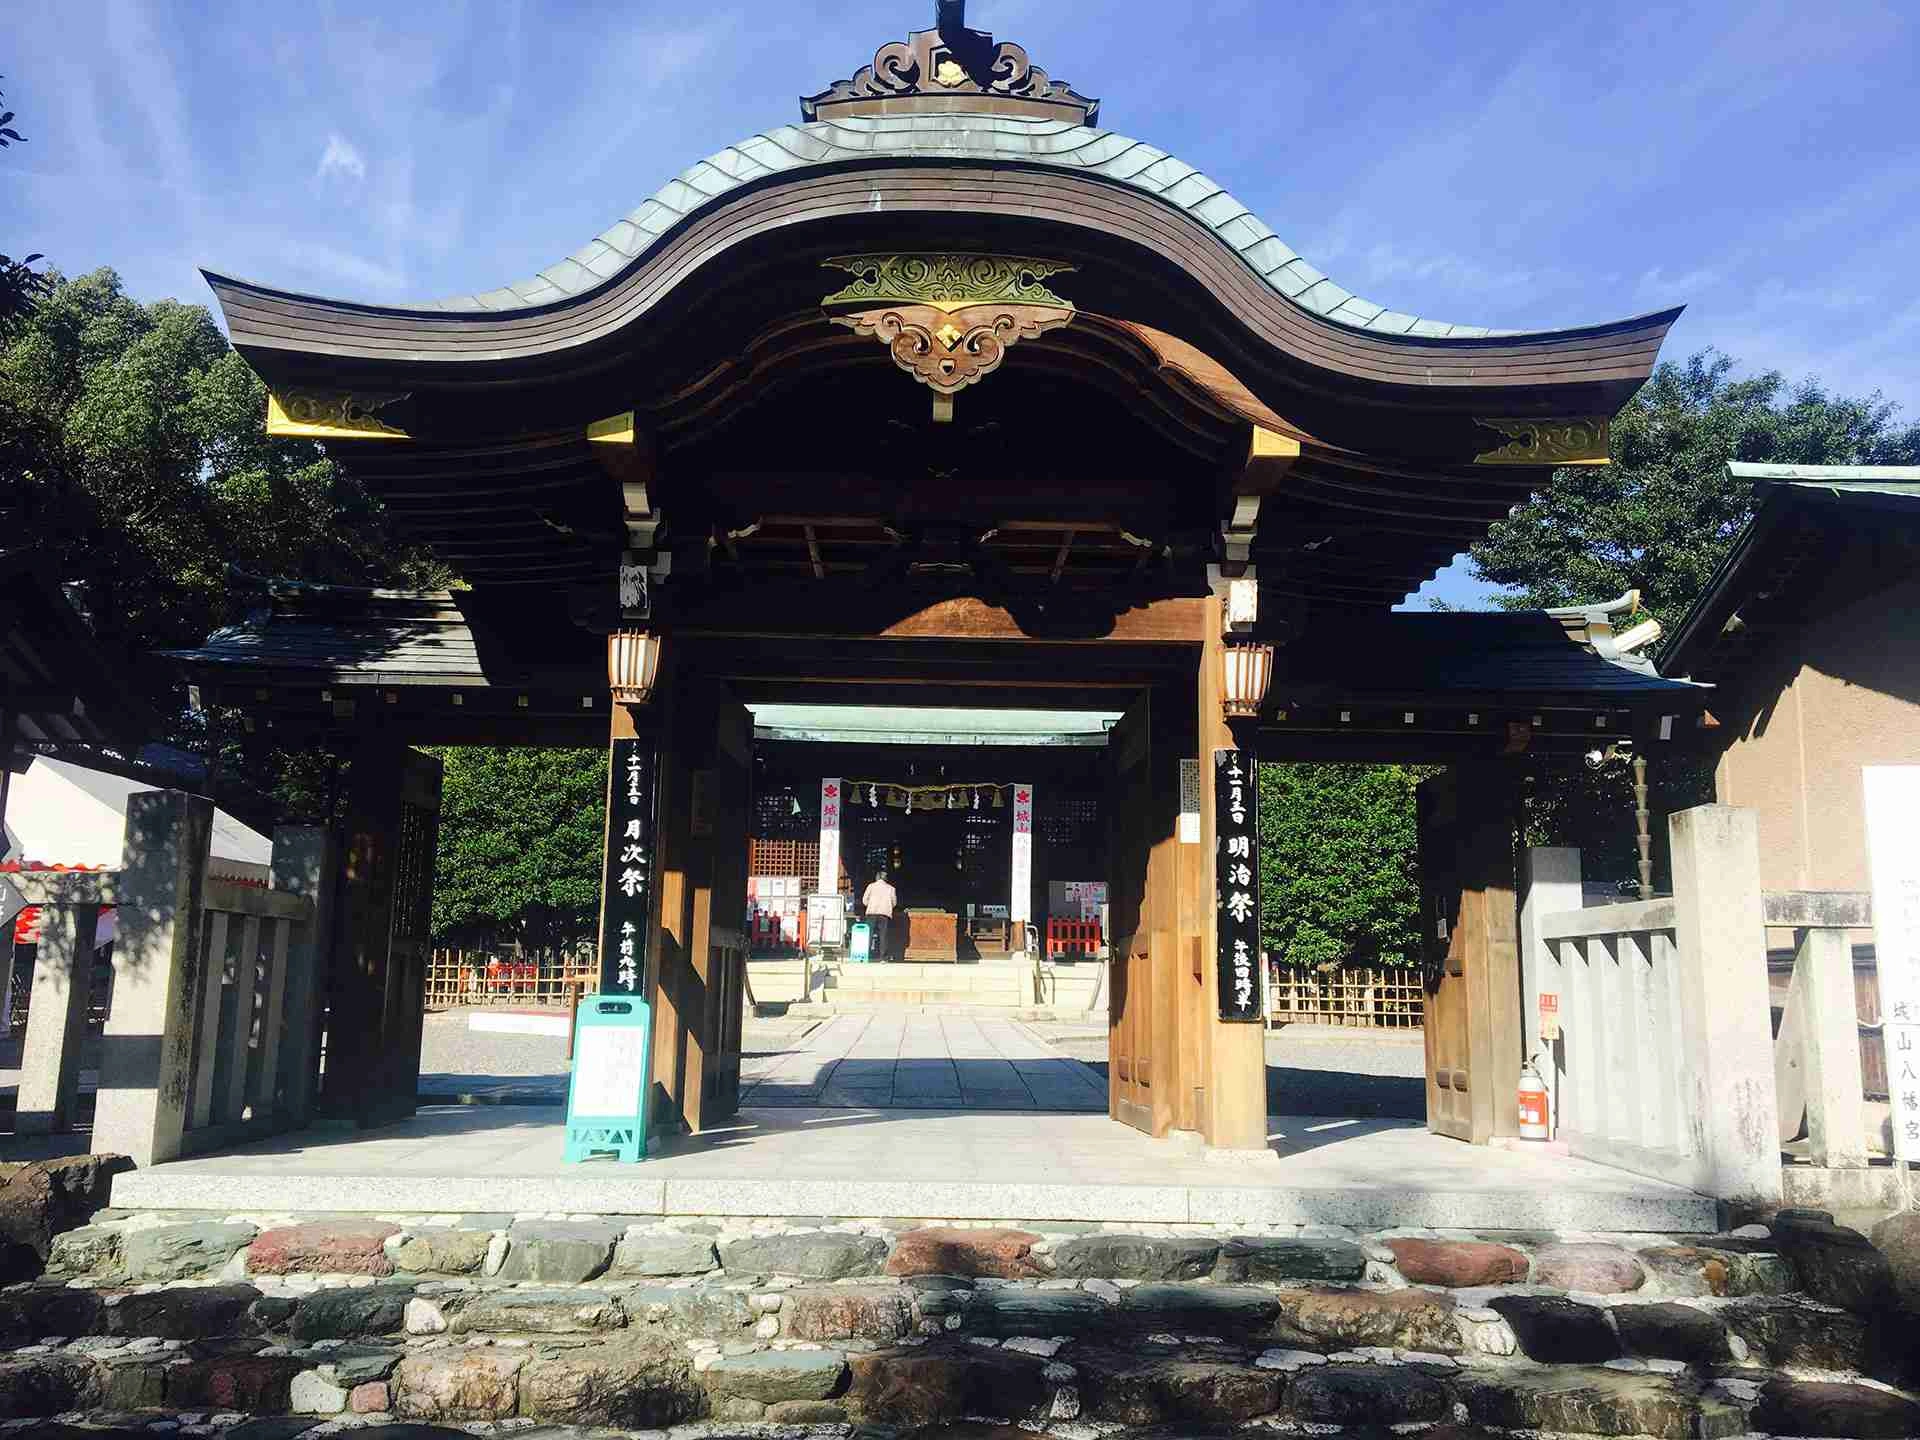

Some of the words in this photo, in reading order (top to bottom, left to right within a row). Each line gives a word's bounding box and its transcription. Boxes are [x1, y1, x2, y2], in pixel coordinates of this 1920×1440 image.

[823, 804, 838, 828] 城山
[1016, 810, 1031, 833] 城山
[1227, 766, 1247, 825] 十一月三日
[618, 819, 647, 898] 月次祭
[1227, 835, 1254, 924] 明治祭
[616, 921, 638, 992] 午前九時
